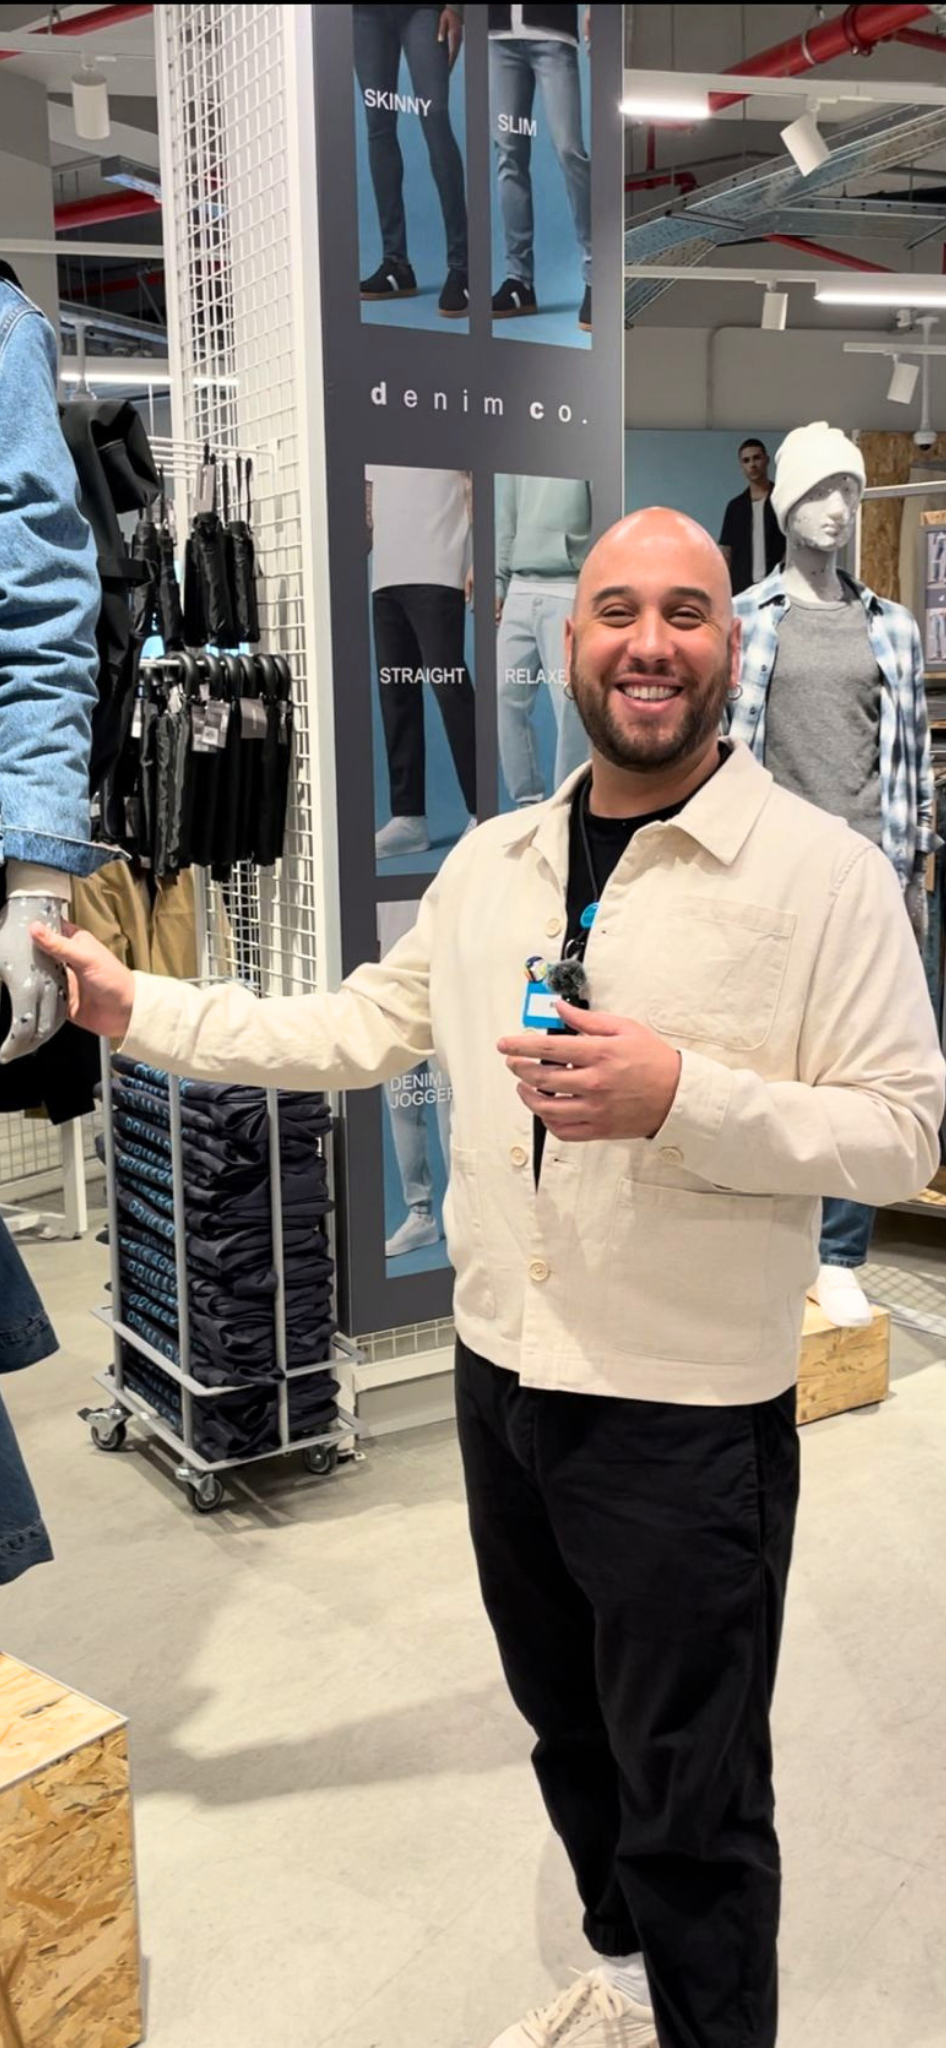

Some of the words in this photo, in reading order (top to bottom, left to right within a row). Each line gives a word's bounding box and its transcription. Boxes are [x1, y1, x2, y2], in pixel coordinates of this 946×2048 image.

[364, 88, 431, 117] SKINNY
[498, 113, 537, 137] SLIM
[370, 381, 504, 415] denim
[529, 401, 588, 424] co.
[379, 667, 465, 684] STRAIGHT
[505, 668, 567, 683] RELAXE
[390, 1071, 442, 1092] DENIM
